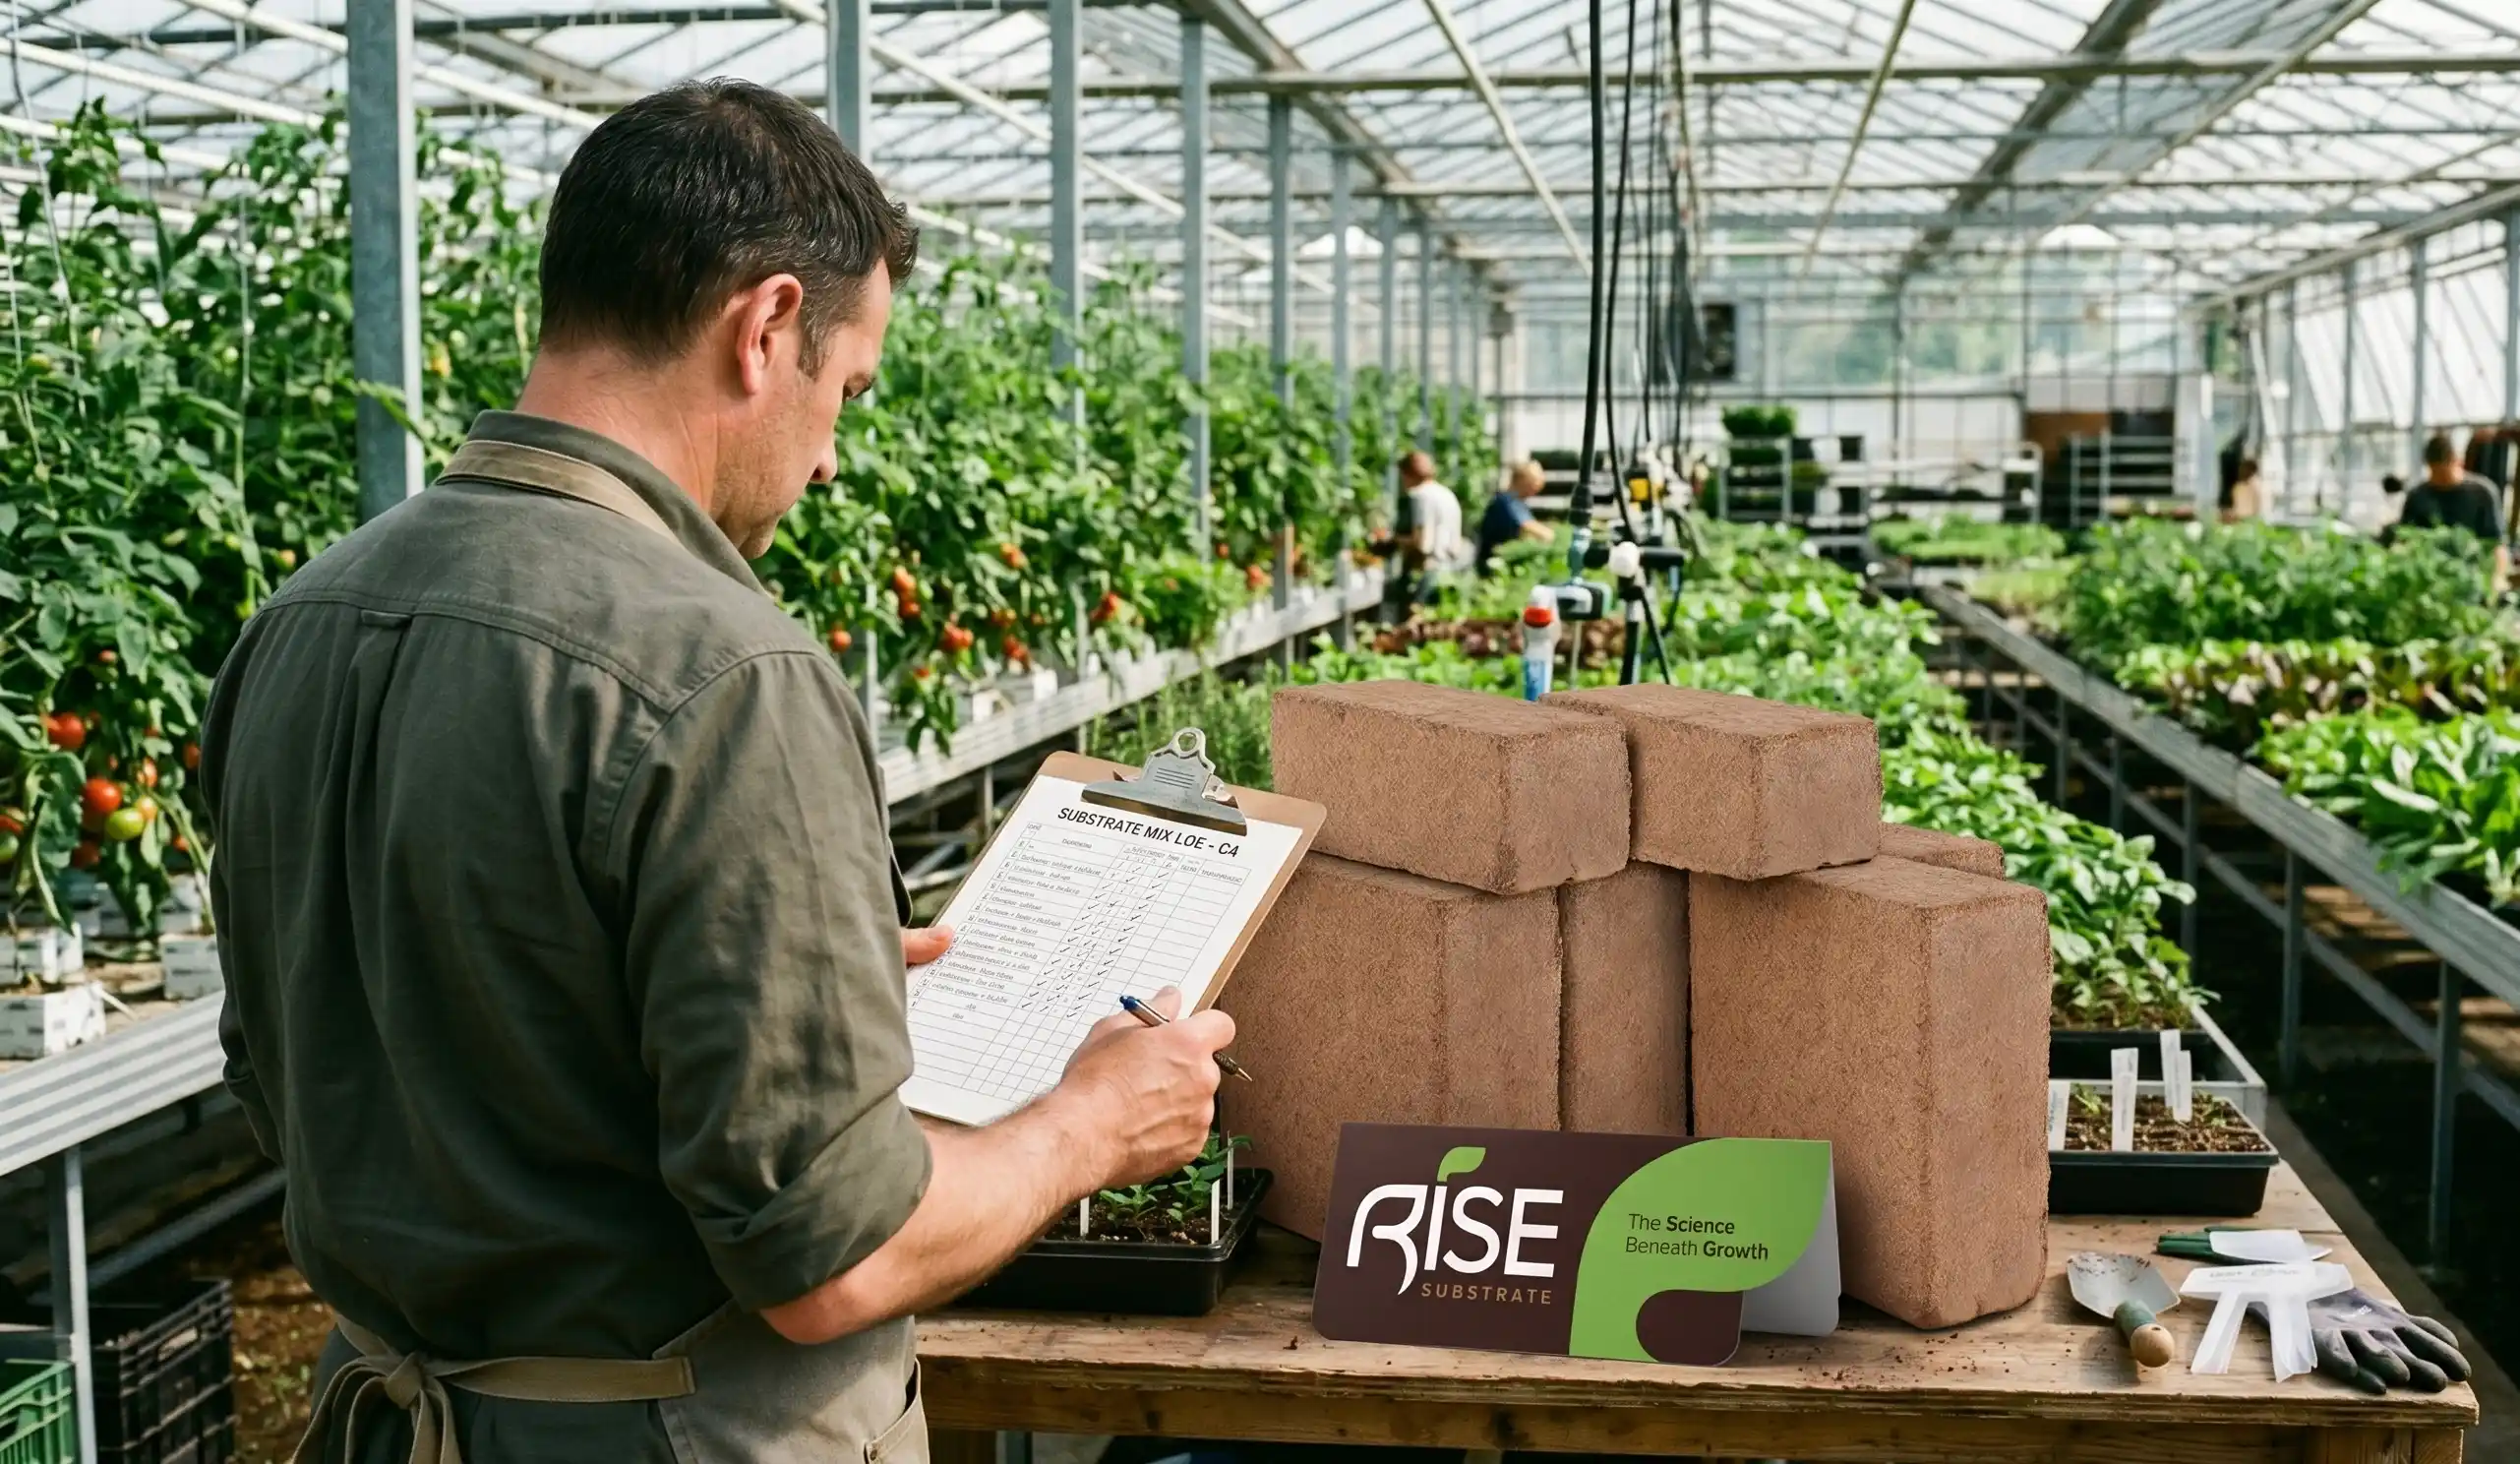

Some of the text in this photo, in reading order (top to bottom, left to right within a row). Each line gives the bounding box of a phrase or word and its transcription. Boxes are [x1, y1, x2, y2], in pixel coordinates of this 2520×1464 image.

[1057, 807, 1144, 836] SUBSTRATE
[1143, 825, 1174, 842] MIX
[1173, 832, 1208, 850] LOE
[1218, 842, 1240, 858] C4
[1628, 1213, 1735, 1235] The Science
[1347, 1184, 1564, 1296] RISE
[1625, 1236, 1769, 1261] Beneath Growth
[1420, 1282, 1552, 1306] SUBSTRATE
